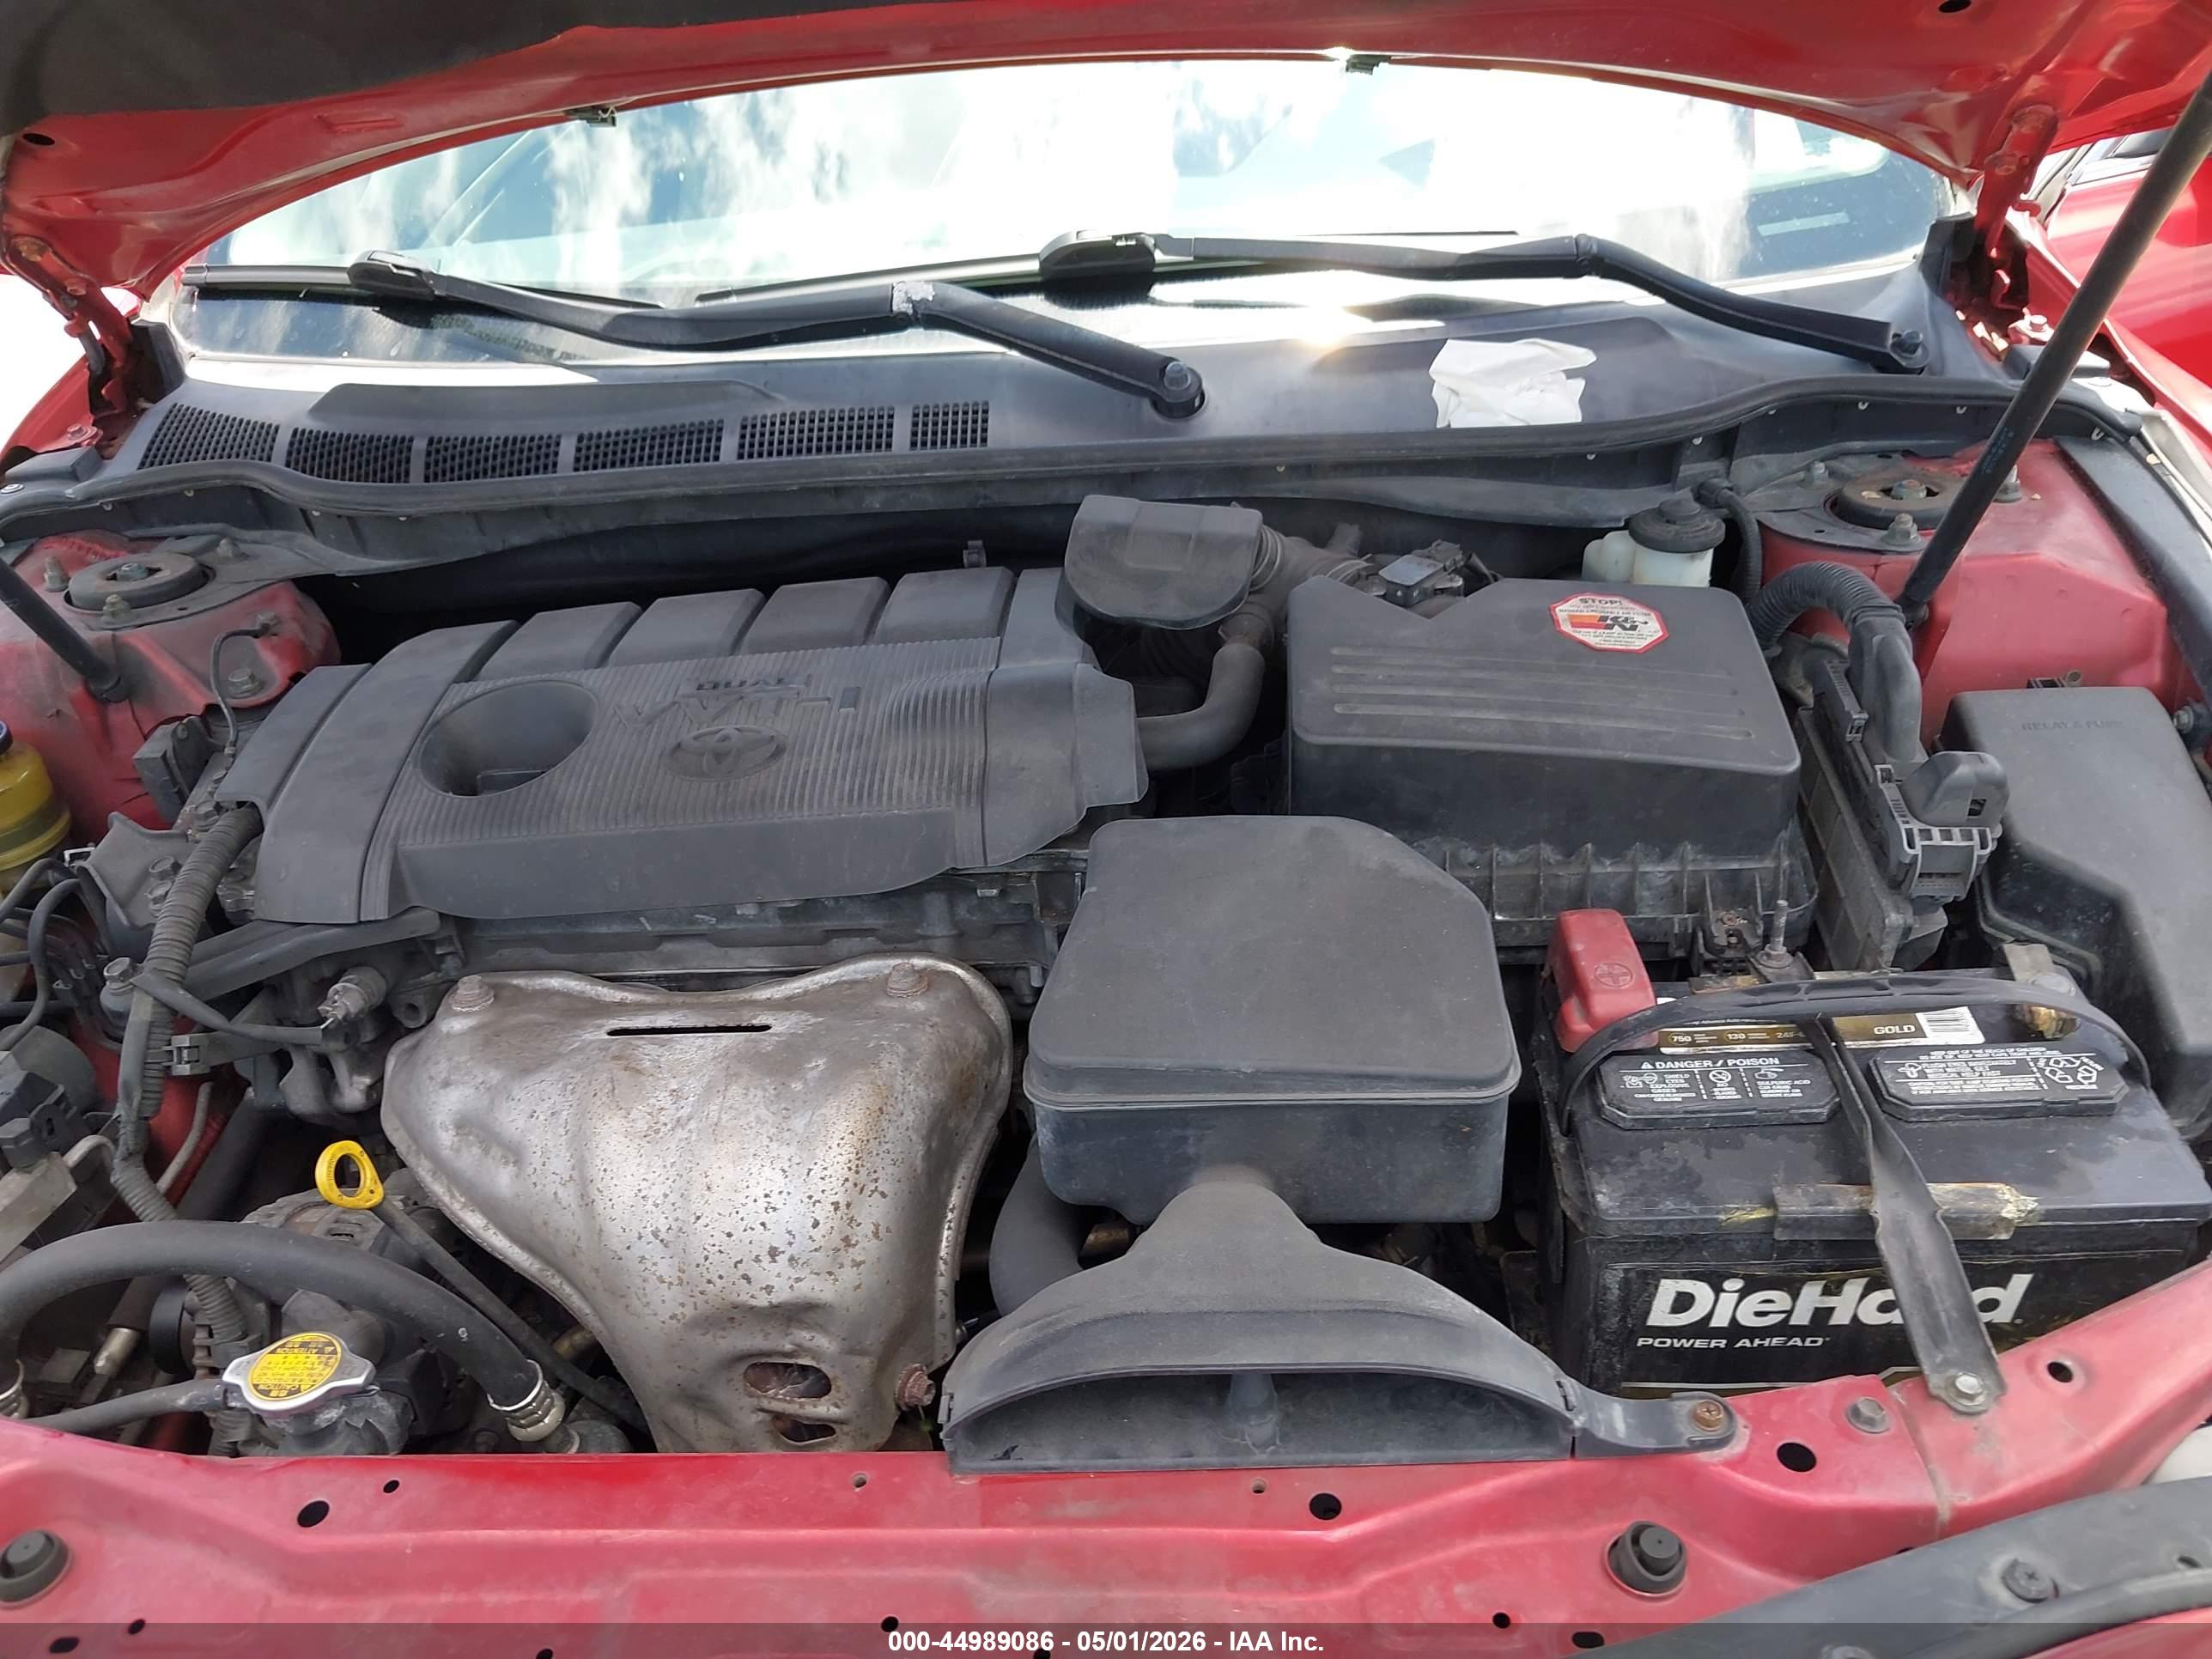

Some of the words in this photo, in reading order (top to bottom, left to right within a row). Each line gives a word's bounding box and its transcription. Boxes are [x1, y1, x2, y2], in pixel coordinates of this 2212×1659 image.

[2021, 720, 2069, 731] RELAY
[1873, 1024, 1916, 1035] GOLD
[1655, 1060, 1714, 1069] DANGER
[1727, 1057, 1780, 1066] POISON
[1645, 1273, 2033, 1328] DieHad
[1636, 1336, 1727, 1349] POWER
[1733, 1335, 1826, 1348] AHEAD
